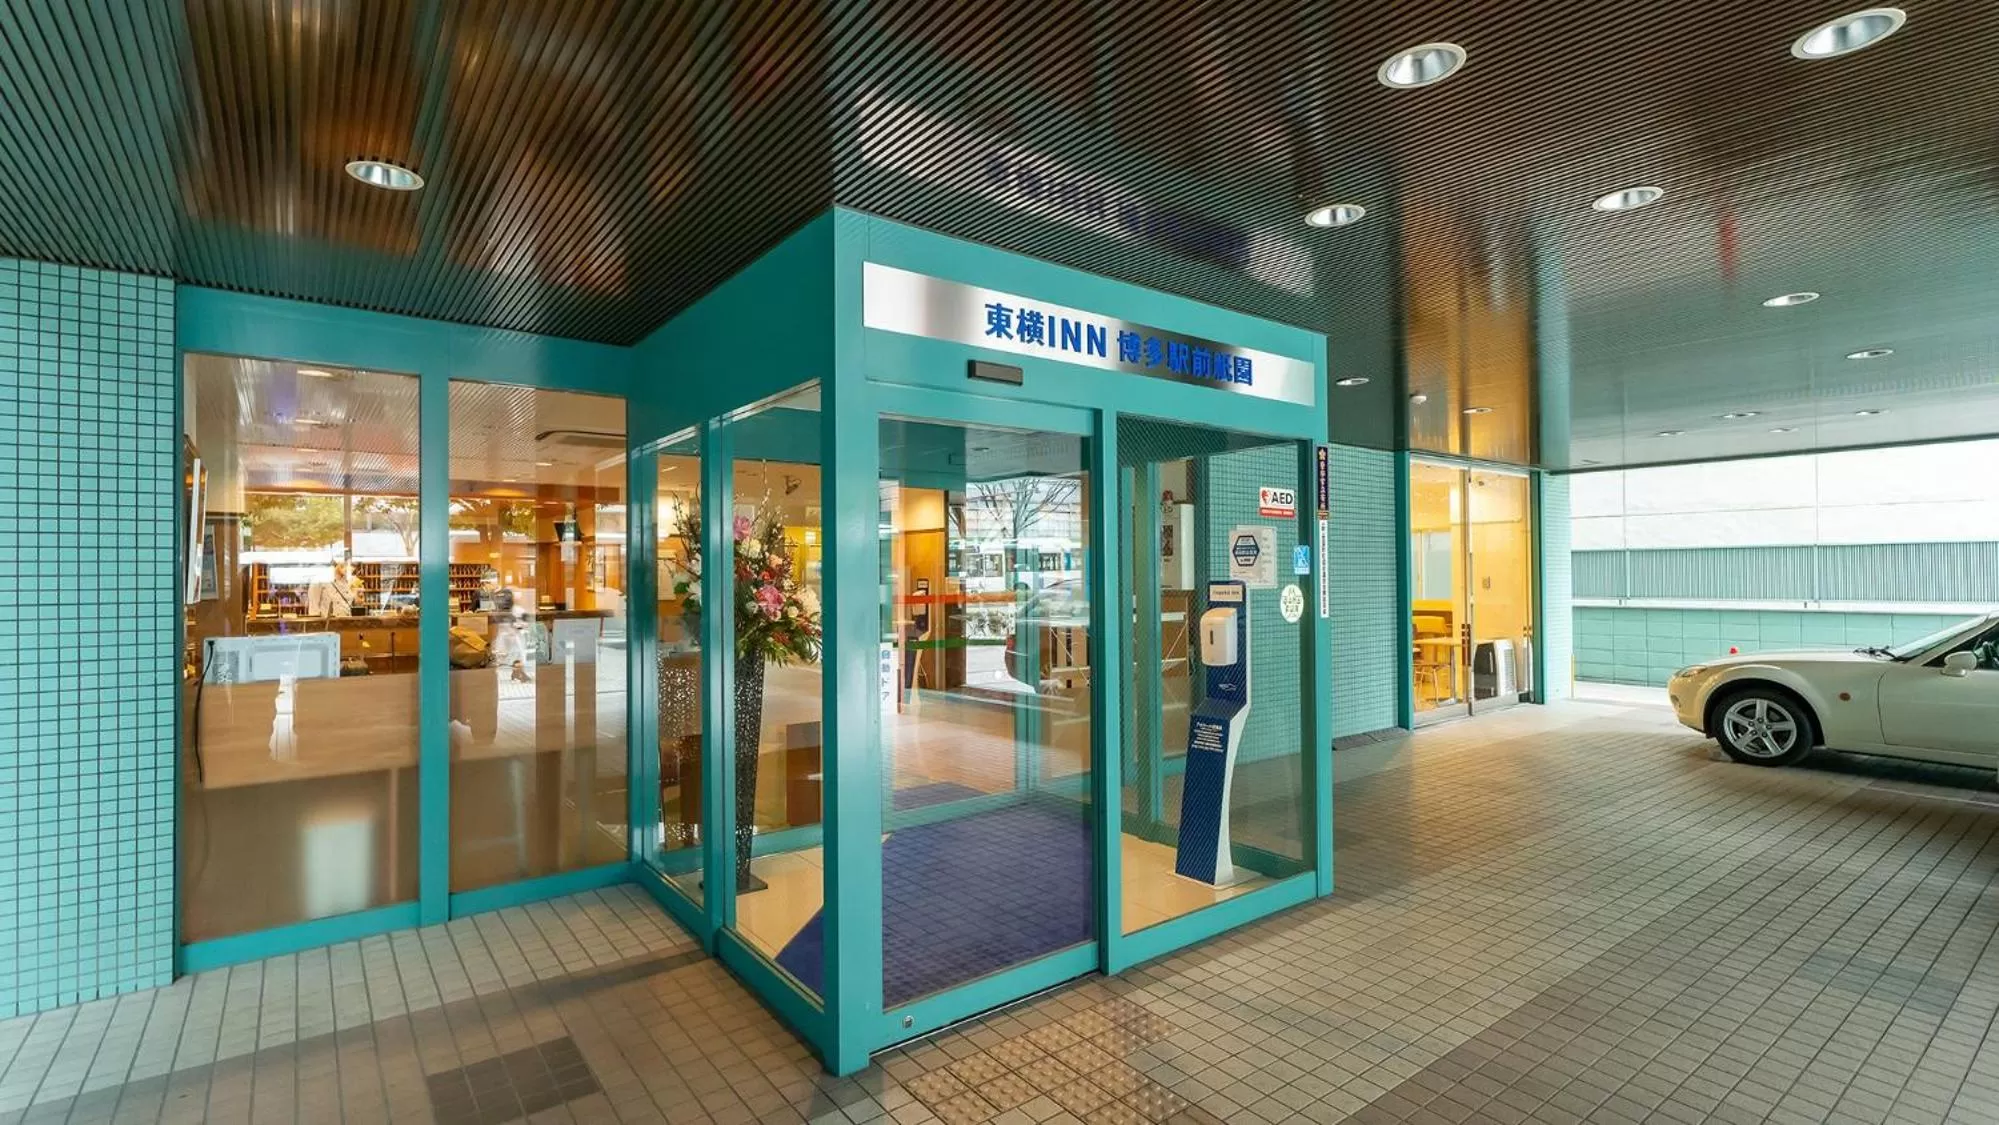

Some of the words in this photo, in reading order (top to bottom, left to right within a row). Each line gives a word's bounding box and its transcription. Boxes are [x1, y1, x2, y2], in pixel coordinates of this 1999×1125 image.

[984, 302, 1107, 358] 東横INN
[1117, 330, 1252, 386] 博多駅前祇園
[1271, 491, 1294, 505] AED
